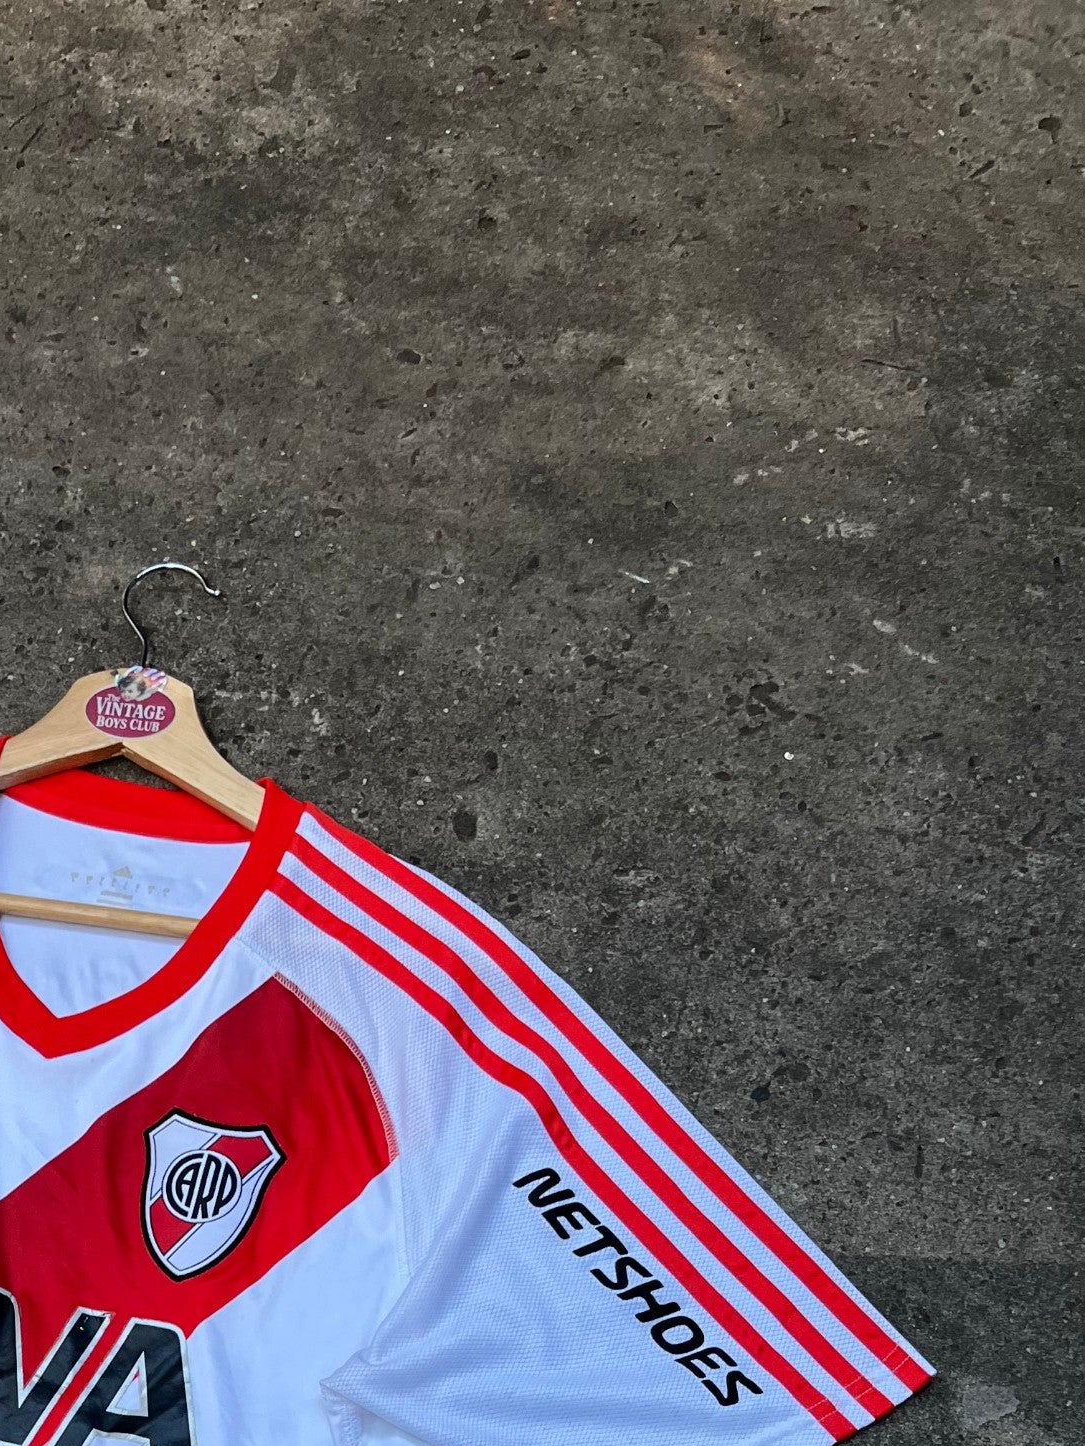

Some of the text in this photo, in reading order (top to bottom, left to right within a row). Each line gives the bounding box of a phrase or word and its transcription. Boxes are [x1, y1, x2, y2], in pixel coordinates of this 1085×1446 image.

[96, 696, 166, 721] VINTAGE
[96, 715, 160, 733] BOYS CLUB
[512, 1167, 764, 1407] NETSHOES
